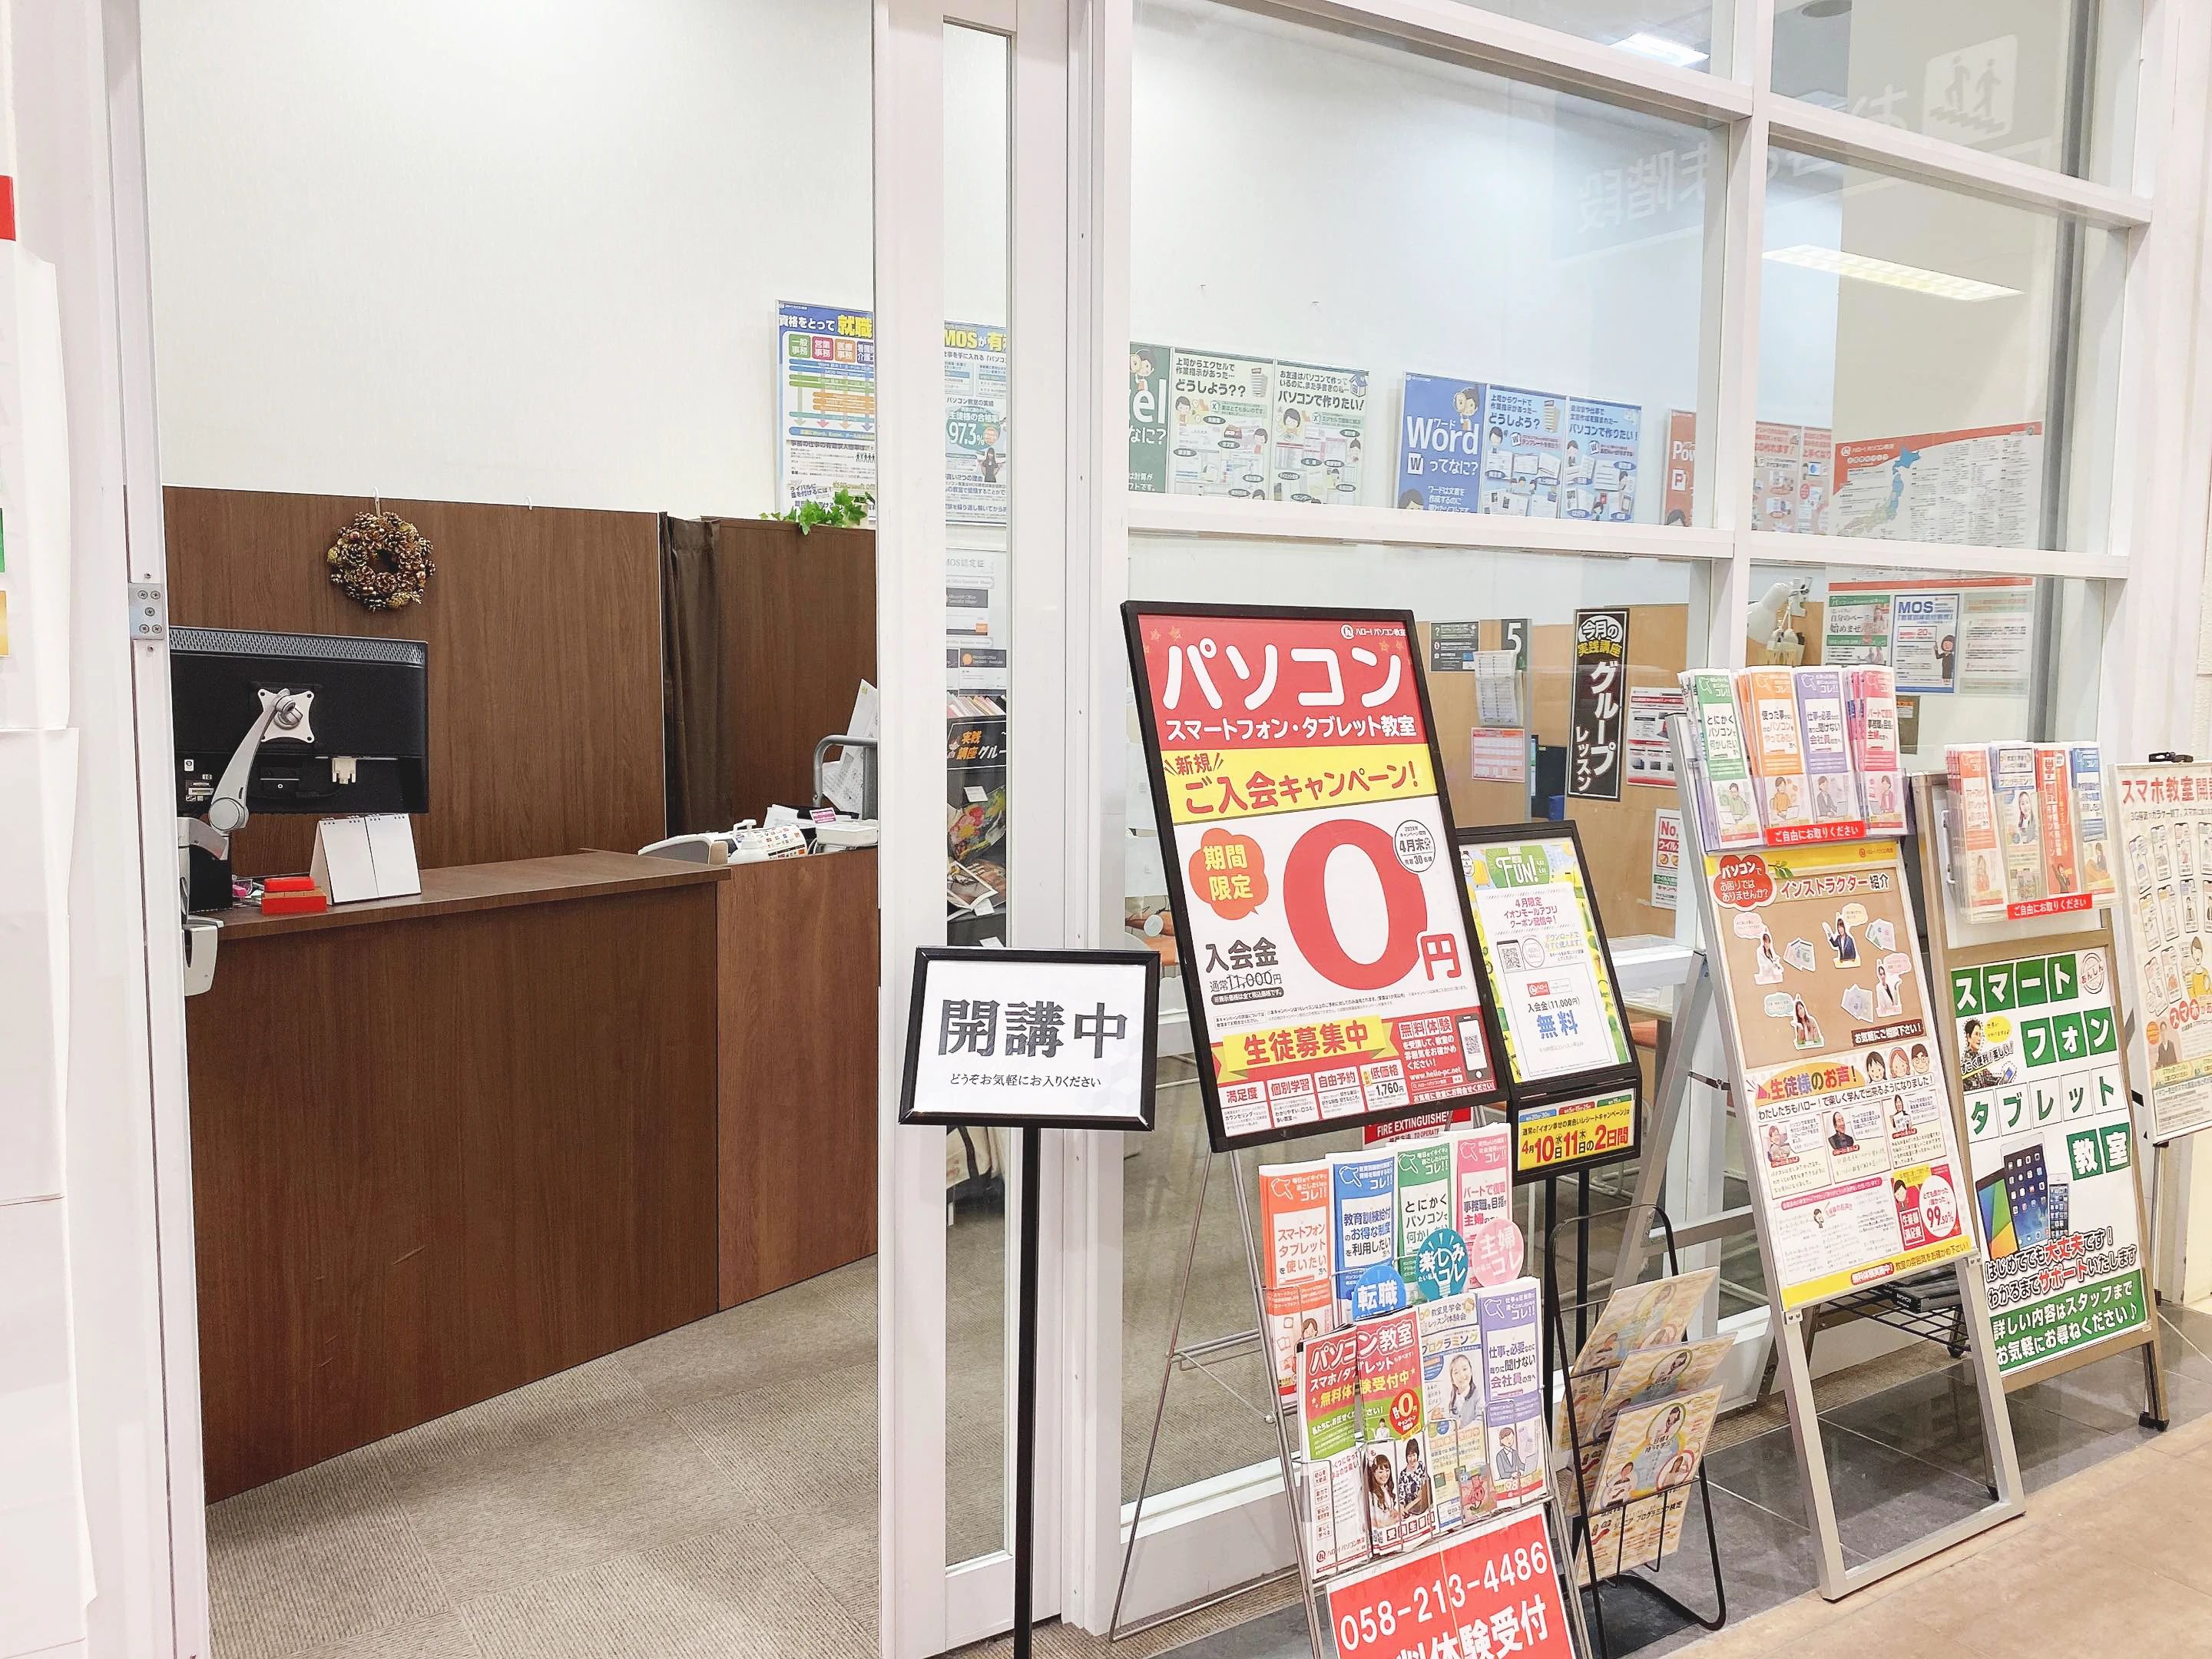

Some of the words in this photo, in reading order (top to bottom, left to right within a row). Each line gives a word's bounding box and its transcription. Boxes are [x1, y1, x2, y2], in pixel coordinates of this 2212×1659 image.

[780, 314, 835, 331] 資格をとって
[837, 314, 873, 338] 就職
[1176, 357, 1235, 372] 上司からエクセルで
[1175, 378, 1246, 398] どうしよう??
[1130, 379, 1167, 425] el
[1277, 390, 1365, 412] パソコンで作りたい!
[949, 422, 985, 446] 97.3%
[1434, 418, 1455, 430] ワード
[1569, 423, 1638, 441] パソコンで作りたい!
[1407, 416, 1479, 455] Word
[1429, 459, 1479, 475] ってなに?
[1898, 601, 1933, 614] MOS
[1506, 622, 1522, 653] 5
[1581, 621, 1618, 641] 今月の
[1578, 638, 1623, 657] 実践講座
[1163, 638, 1401, 710] パソコン
[1166, 715, 1417, 741] スマートフォン・タブレット教室
[1590, 661, 1619, 777] グループ
[1707, 714, 1734, 725] とにかく
[1175, 753, 1212, 775] 新規
[1576, 726, 1592, 792] レッスン
[1186, 761, 1419, 813] ご入会キャンペーン!
[2121, 776, 2212, 804] スマホ教室開
[1775, 824, 1859, 843] ご自由にお取りください
[1204, 845, 1247, 871] 期間
[1721, 861, 1762, 880] パソコンで
[1209, 876, 1253, 900] 限定
[1720, 878, 1755, 892] お困りでは
[1780, 873, 1889, 899] インストラクター紹介
[1515, 897, 1543, 907] 4月限定
[1721, 888, 1769, 903] ありませんか?
[1504, 905, 1558, 919] イオンモールアプリ
[2015, 897, 2088, 916] ご自由にお取りください
[1205, 937, 1278, 973] 入会金
[2081, 965, 2104, 985] あんしん
[1955, 962, 2071, 1011] スマート
[1528, 998, 1580, 1013] 入会金(11,000円)
[1400, 1018, 1452, 1038] 無料体験
[1536, 1009, 1578, 1039] 無料
[1243, 1020, 1369, 1066] 生徒募集中
[2027, 1018, 2109, 1060] フォン
[1371, 1064, 1399, 1080] 低価格
[1407, 1058, 1437, 1070] ください!
[1409, 1066, 1462, 1081] www.hello-pc.net
[1271, 1078, 1310, 1096] 個別学習
[1319, 1071, 1356, 1088] 自由予約
[1770, 1065, 1857, 1100] 生徒様のお声!
[1226, 1087, 1258, 1104] 満足度
[1758, 1078, 1934, 1120] わたしたちもハロー!で楽しく学んで出来るようになりました!
[1971, 1076, 2114, 1135] タブレット
[1376, 1123, 1393, 1137] FIRE
[2072, 1131, 2129, 1174] 教室
[1425, 1160, 1449, 1175] コレ!!
[1369, 1176, 1393, 1190] コレ!!
[1300, 1187, 1327, 1201] コレ!!
[1405, 1193, 1448, 1213] とにかく
[1343, 1207, 1391, 1227] 教育訓練給付
[1406, 1211, 1448, 1229] パソコンで
[1926, 1205, 1954, 1228] 99.50%
[1278, 1223, 1325, 1241] スマートフォン
[1344, 1221, 1391, 1241] のお得な制度
[1279, 1238, 1326, 1258] タブレット
[1345, 1237, 1391, 1257] を利用したい
[1479, 1227, 1515, 1260] 主婦
[1985, 1226, 2114, 1282] はじめてでも大丈夫です!
[1280, 1255, 1326, 1274] を使いたい
[1987, 1244, 2137, 1309] わかるまでサポートいたします
[1357, 1280, 1398, 1312] 転職
[1512, 1306, 1535, 1321] コレ!!
[1993, 1280, 2133, 1342] 詳しい内容はスタッフまで
[1310, 1323, 1414, 1375] パソコン教室
[1422, 1331, 1479, 1354] プログラミング
[1488, 1341, 1535, 1360] 仕事で必要なのに
[1320, 1369, 1409, 1408] 無料体験受付中
[1490, 1371, 1537, 1389] 会社員の方へ
[1341, 1541, 1548, 1651] 058-213-4486
